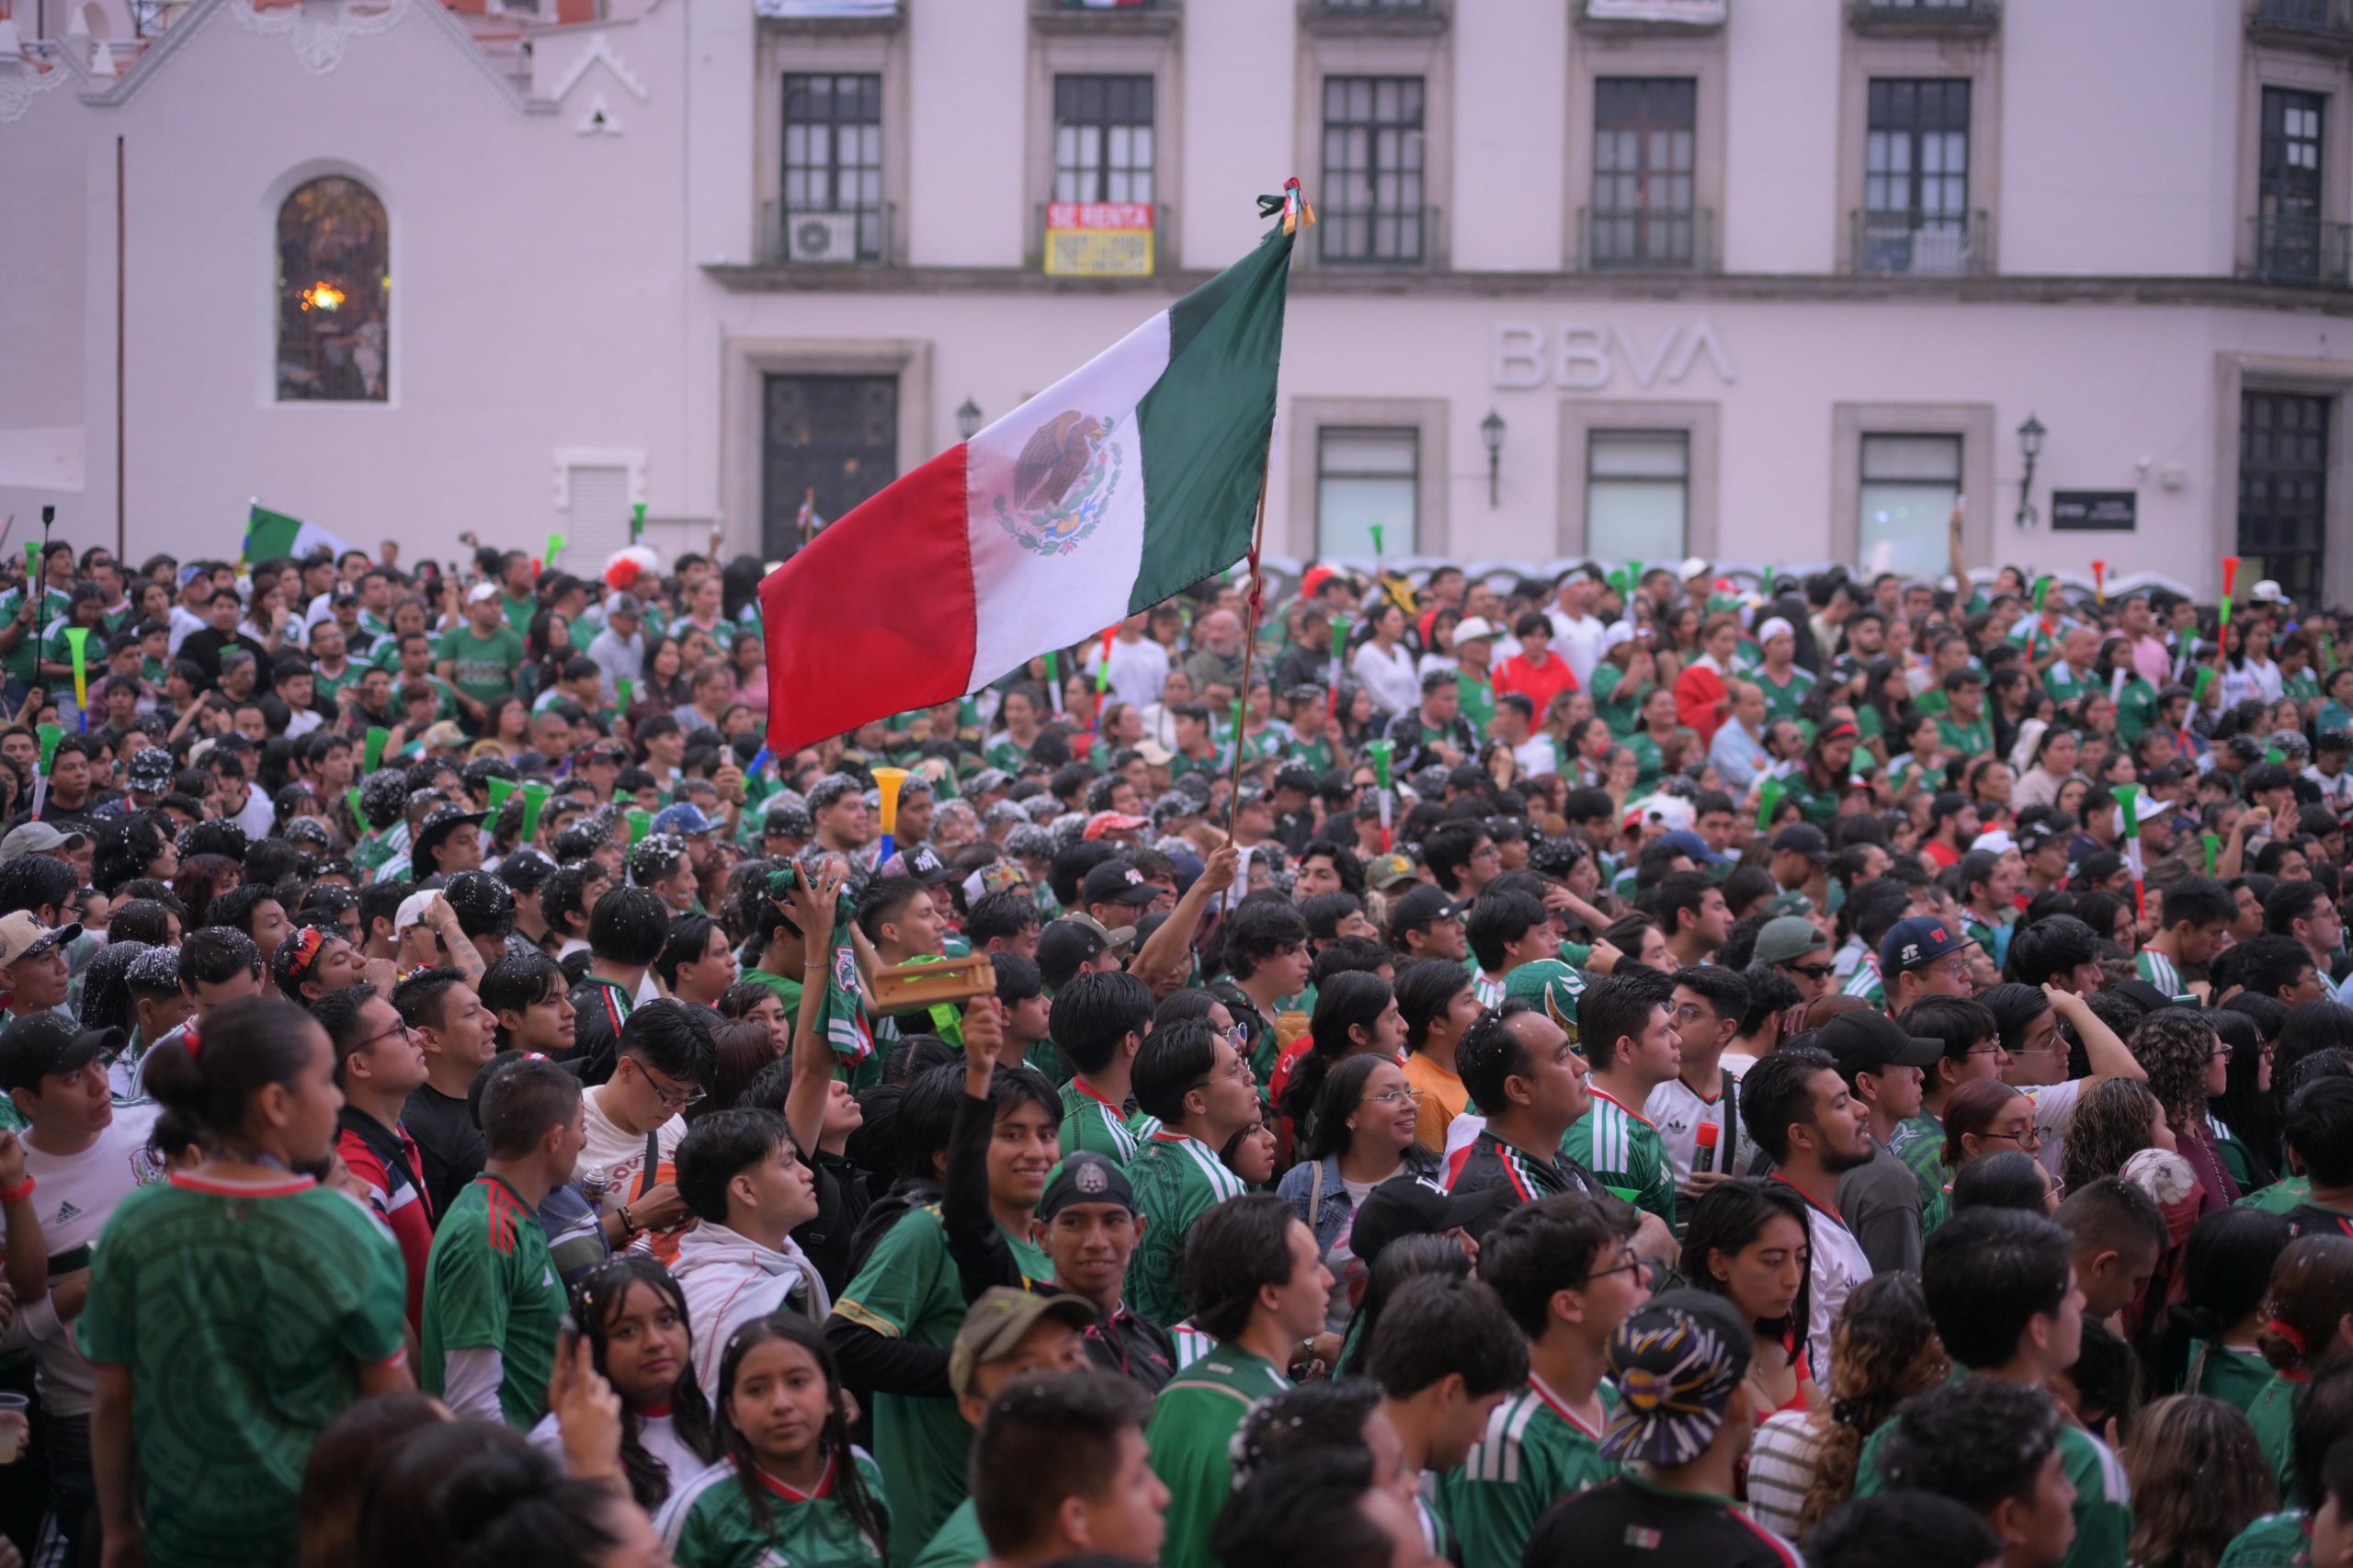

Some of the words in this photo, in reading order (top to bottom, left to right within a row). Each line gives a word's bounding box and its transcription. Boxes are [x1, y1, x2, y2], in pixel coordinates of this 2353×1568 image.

[1049, 204, 1077, 227] SE
[1082, 204, 1149, 228] RENTA
[1491, 316, 1736, 391] BBVA
